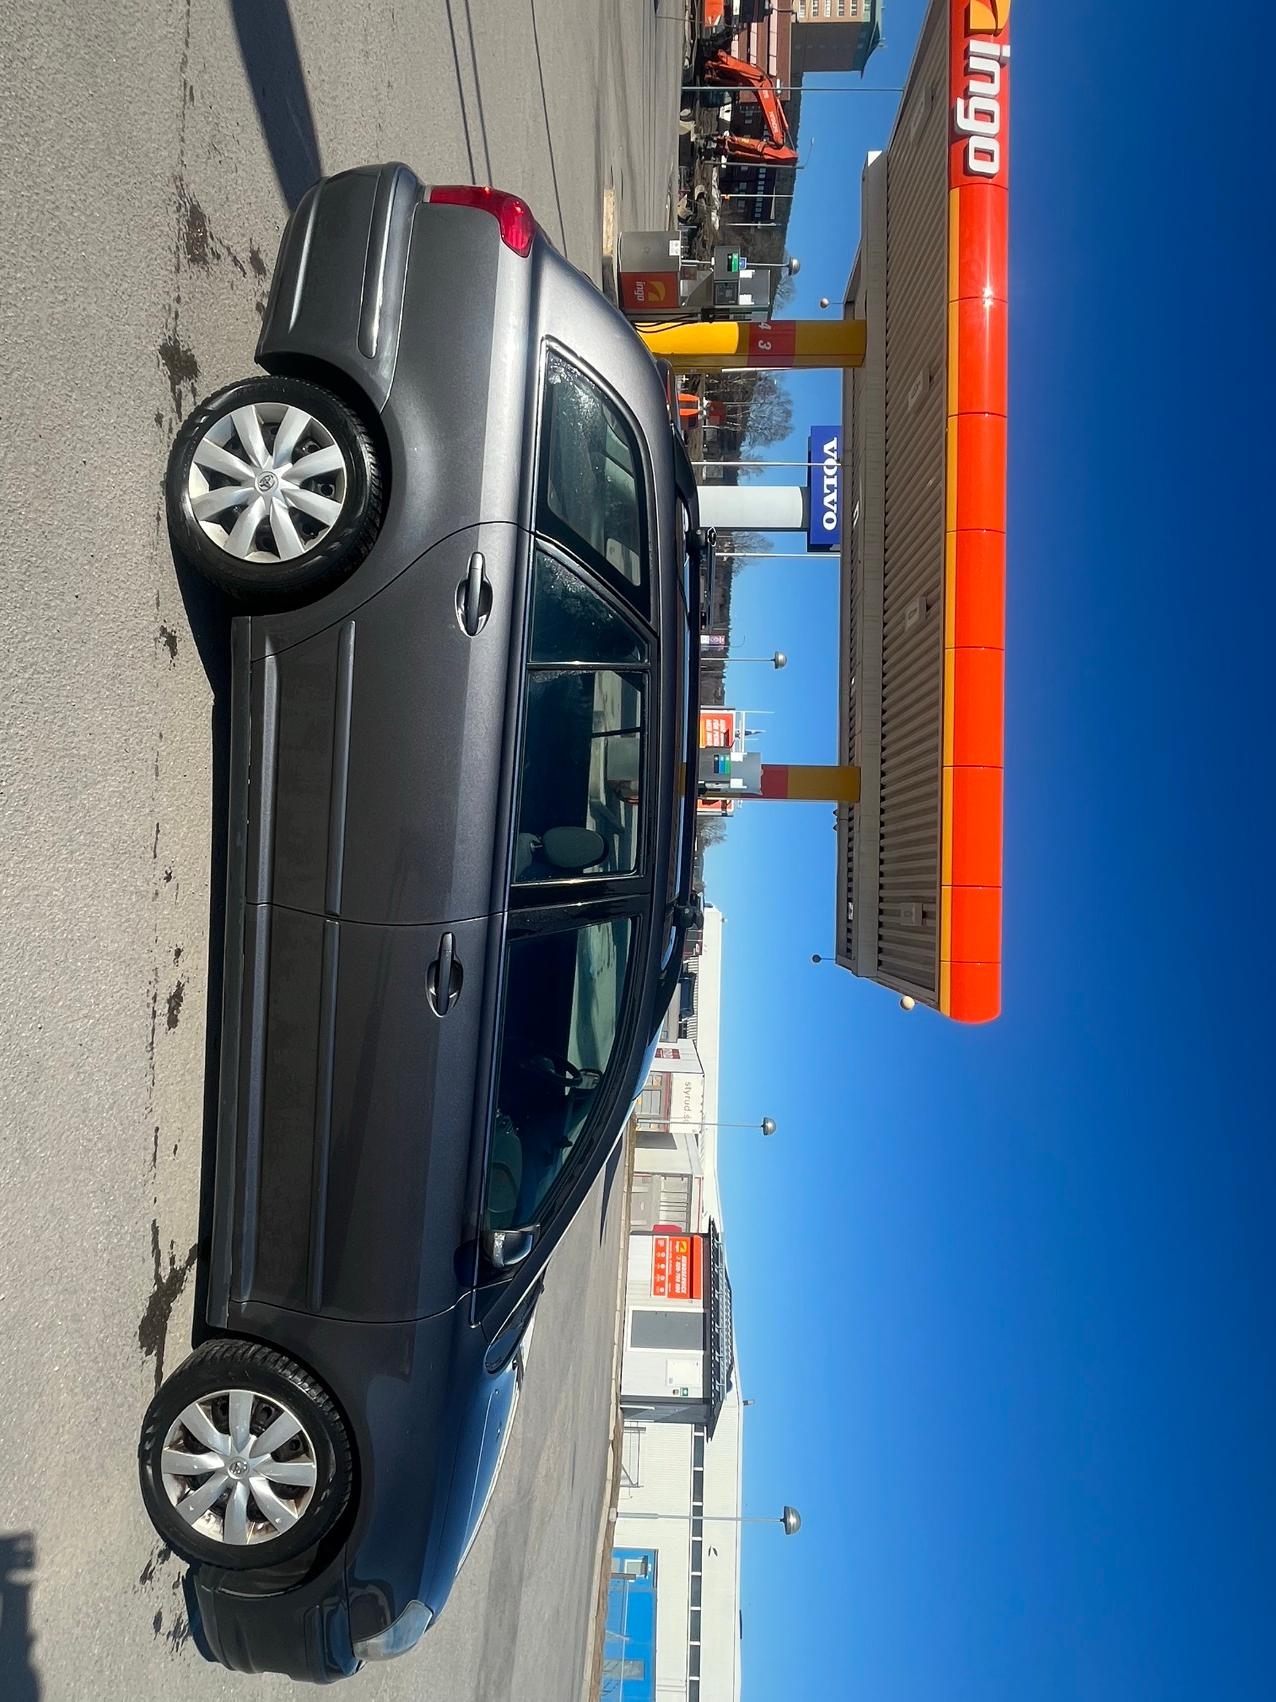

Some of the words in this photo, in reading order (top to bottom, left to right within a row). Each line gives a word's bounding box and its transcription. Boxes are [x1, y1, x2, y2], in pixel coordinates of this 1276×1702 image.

[955, 39, 1011, 176] ingo
[633, 281, 647, 301] ingo
[758, 322, 772, 331] 4
[758, 340, 772, 351] 3
[822, 437, 838, 531] VOLVO
